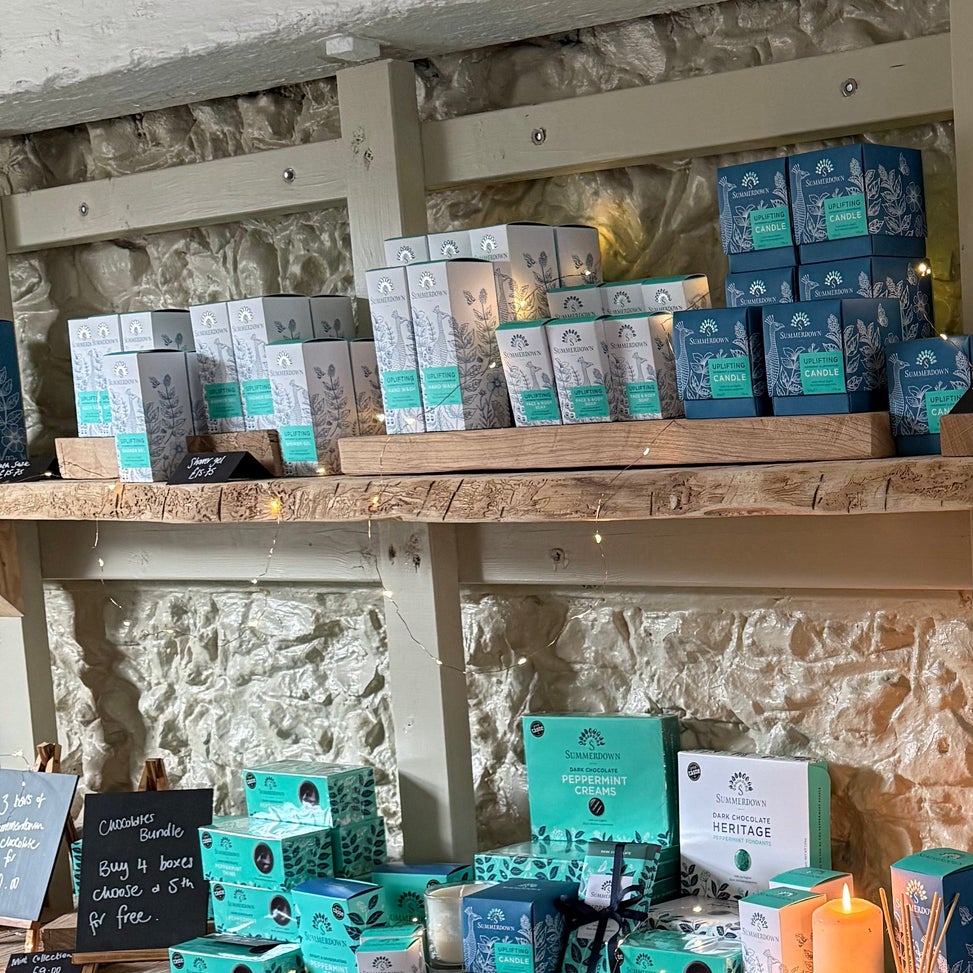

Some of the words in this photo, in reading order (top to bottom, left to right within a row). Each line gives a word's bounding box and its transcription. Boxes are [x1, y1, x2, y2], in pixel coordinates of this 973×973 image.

[828, 200, 861, 210] UPLIFTING
[753, 211, 785, 221] UPLIFTING
[829, 211, 862, 222] CANDLE
[755, 222, 786, 233] CANDLE
[780, 330, 822, 339] SUMMERDOWN
[689, 336, 729, 345] SUMMERDOWN
[803, 356, 839, 364] UPLIFTING
[712, 362, 746, 370] UPLIFTING
[804, 368, 840, 377] CANDLE
[904, 368, 949, 378] SUMMERDOWN
[713, 374, 747, 382] CANDLE
[565, 750, 621, 760] SUMMERDOWN
[562, 774, 628, 786] PEPPERMINT
[574, 786, 617, 796] CREAMS
[716, 793, 767, 807] SUMMERDOWN
[712, 812, 730, 820] DARK
[731, 814, 771, 824] CHOCOLATE
[139, 820, 185, 842] Bundle
[712, 822, 772, 838] HERITAGE
[713, 835, 743, 844] PEPPERMINT
[745, 838, 772, 846] FONDANTS
[98, 860, 130, 881] Buy
[137, 858, 148, 874] 4
[159, 854, 194, 870] boxes
[92, 882, 144, 902] choose
[151, 883, 161, 893] a
[167, 876, 195, 895] 5th
[89, 911, 107, 935] for
[116, 905, 159, 929] free.
[498, 946, 529, 955] UPLIFTING
[32, 952, 73, 963] Collection
[498, 956, 530, 965] CANDLE
[310, 960, 349, 973] PEPPERMINT
